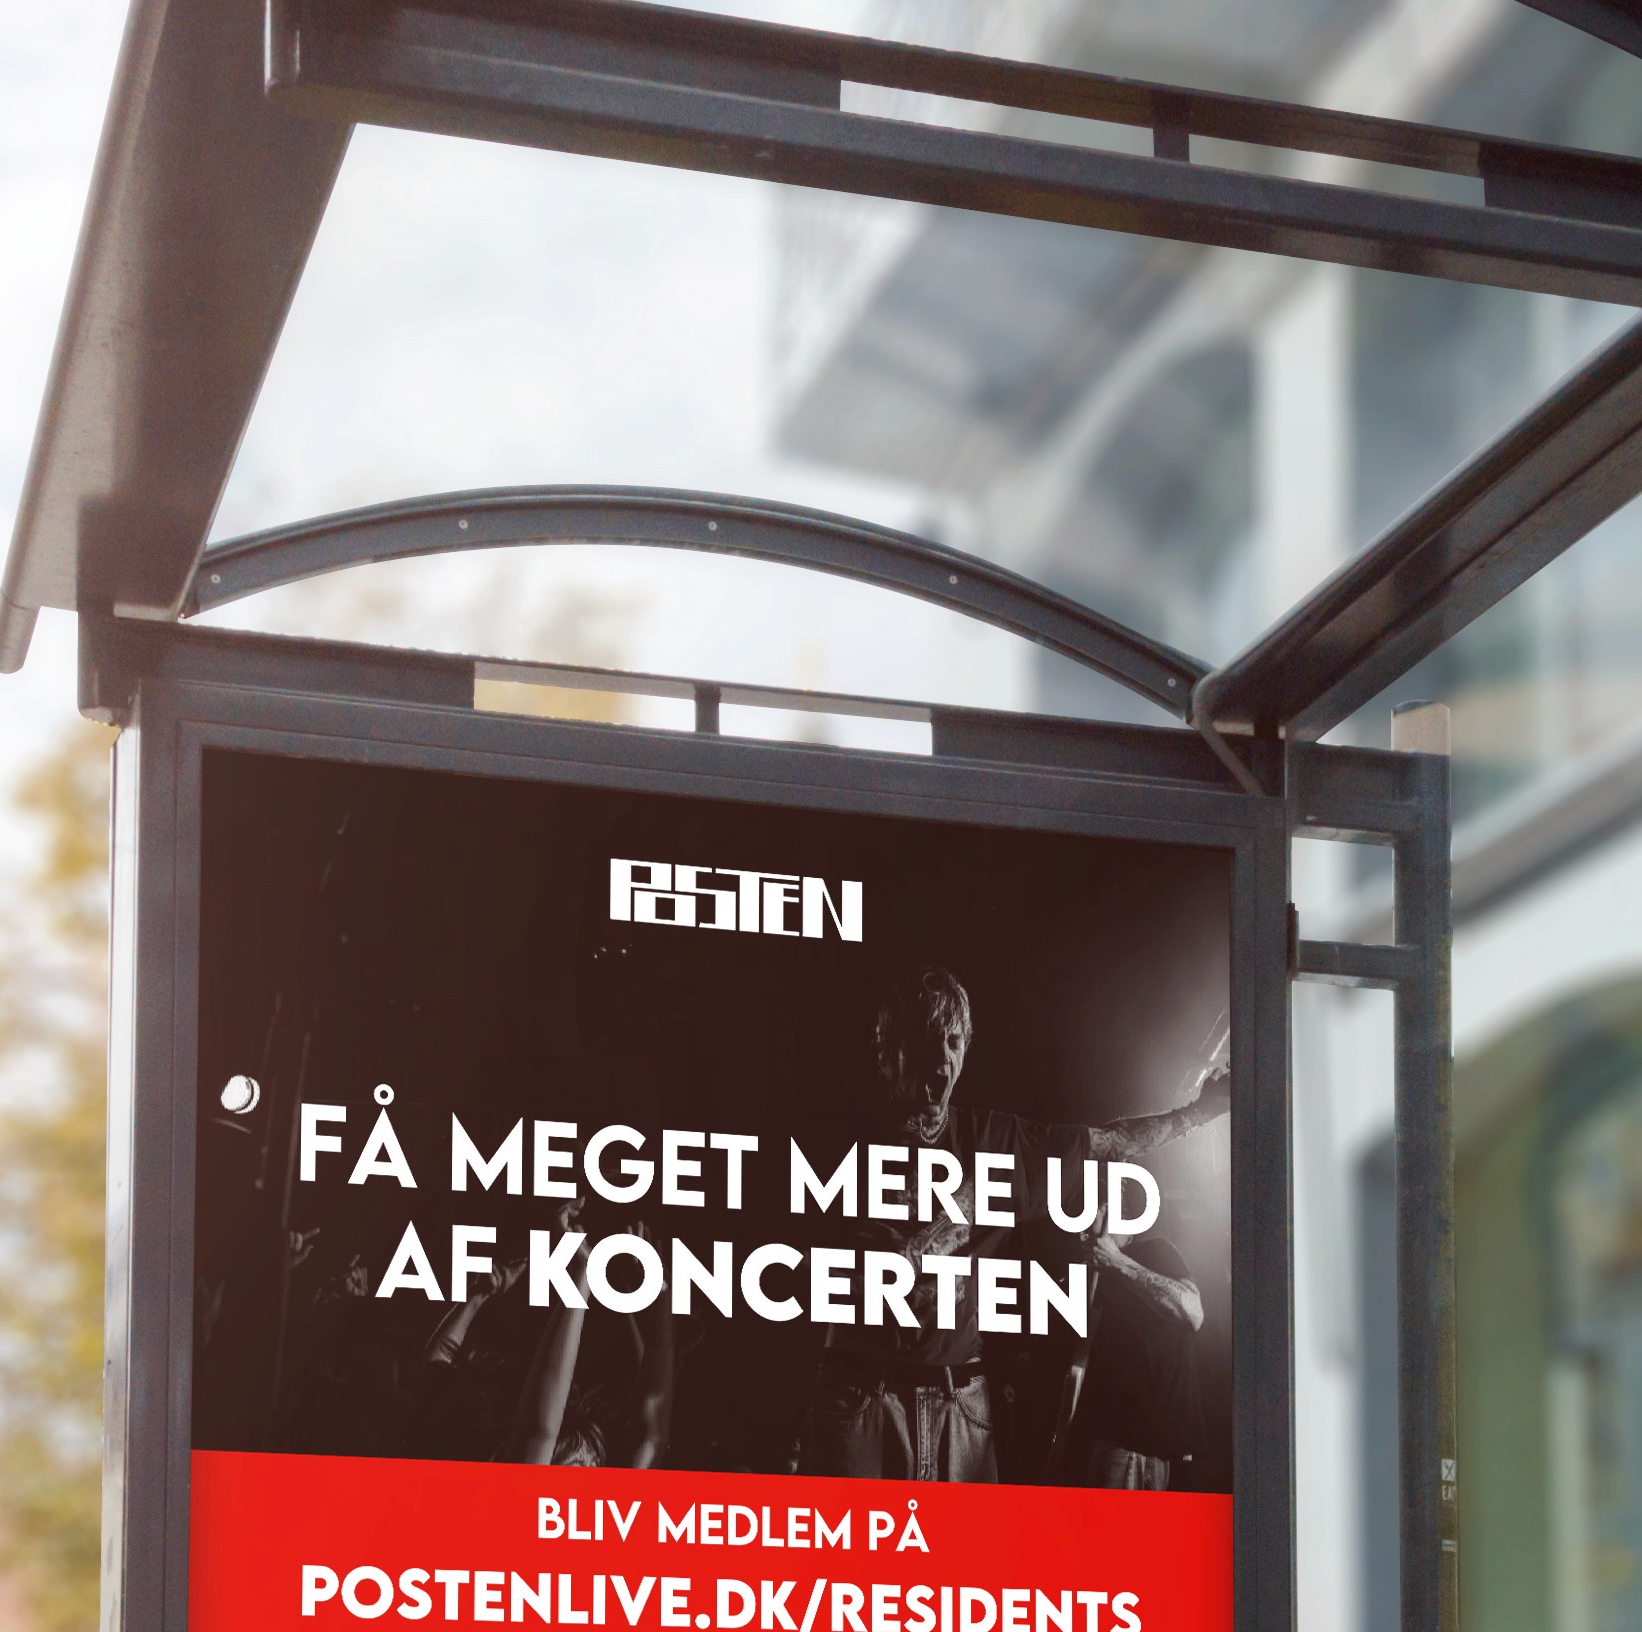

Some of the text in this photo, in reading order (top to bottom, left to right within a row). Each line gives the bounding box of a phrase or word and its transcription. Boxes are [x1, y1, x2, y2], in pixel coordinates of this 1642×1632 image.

[609, 858, 863, 943] POSTEN
[299, 1083, 1161, 1236] FÅ MEGET MERE UD
[374, 1220, 1090, 1339] AF KONCERTEN
[537, 1496, 931, 1553] BLIV MEDLEM PÅ
